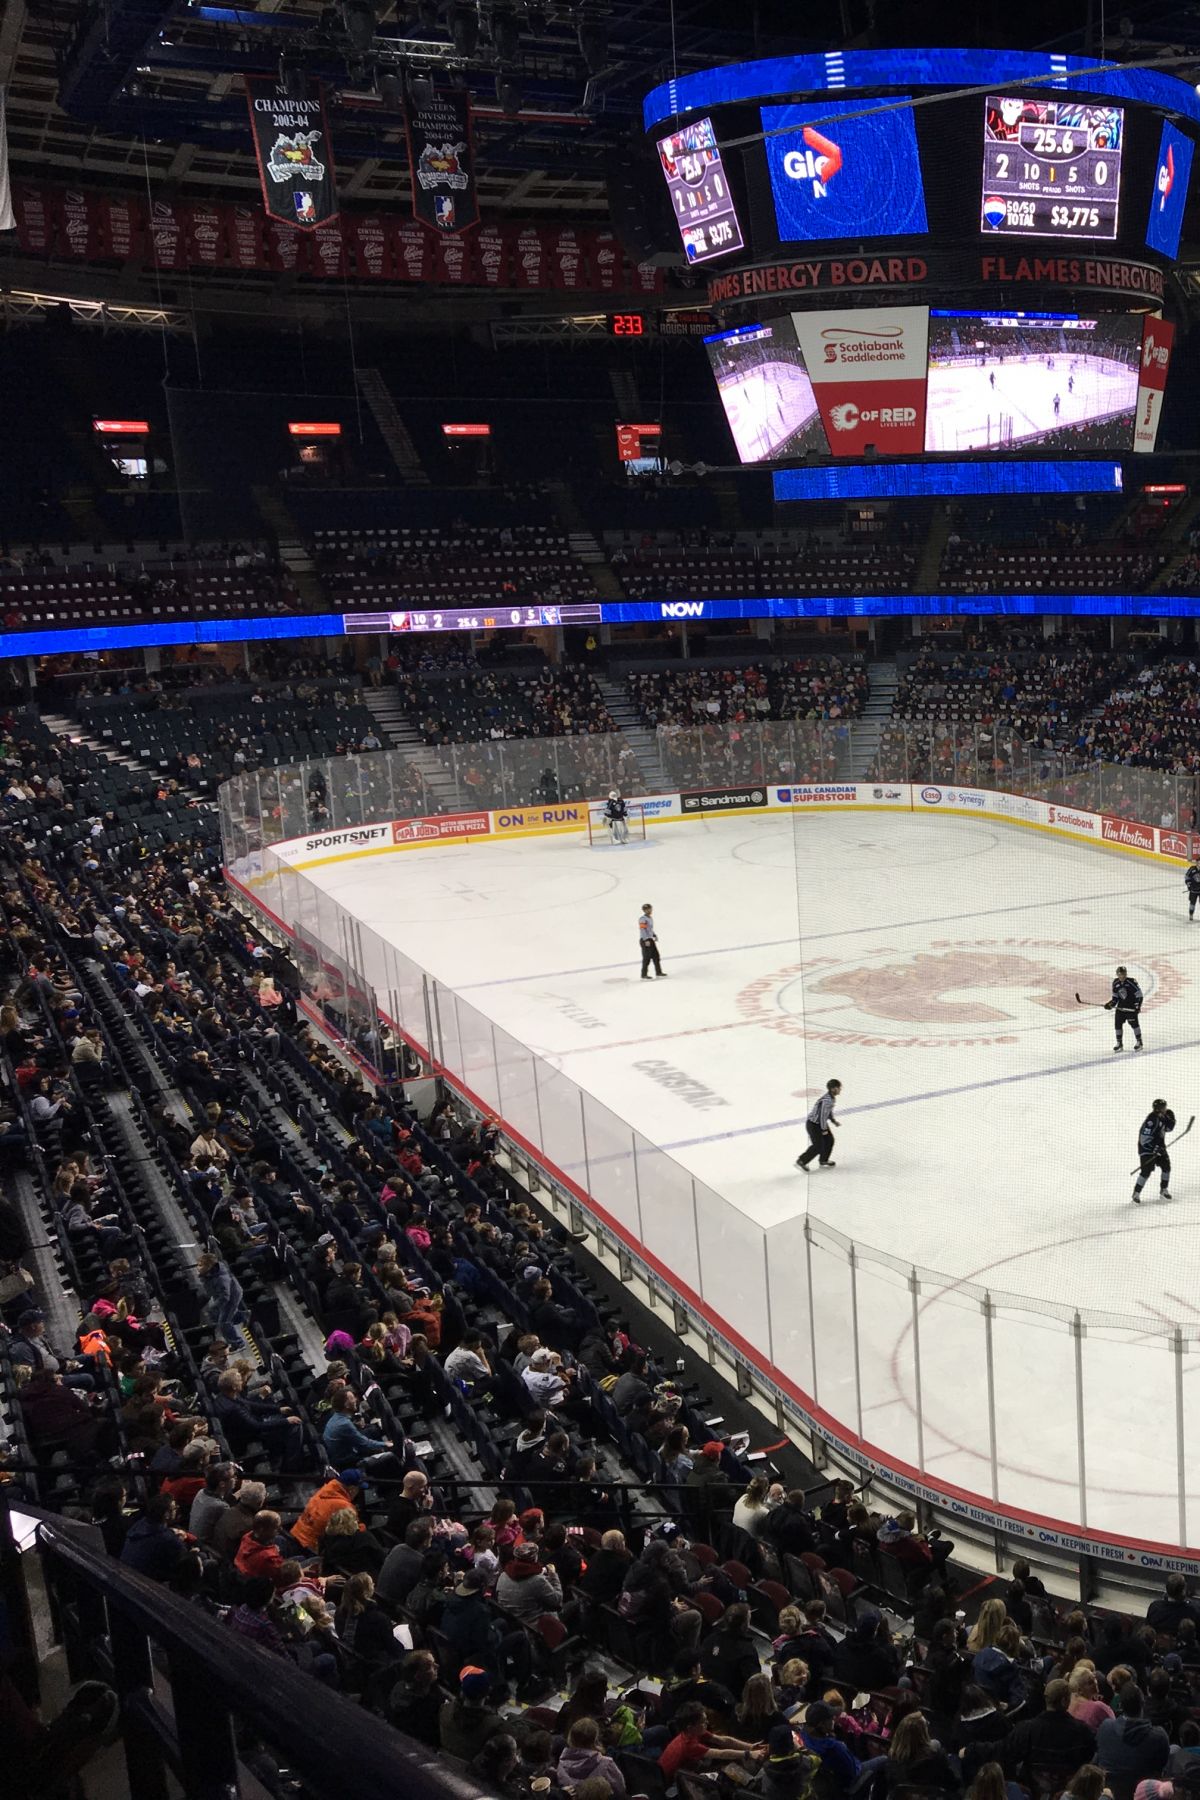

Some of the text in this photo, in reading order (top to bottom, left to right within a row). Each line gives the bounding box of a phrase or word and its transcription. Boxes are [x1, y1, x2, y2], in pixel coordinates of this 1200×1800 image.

[255, 99, 321, 113] CHAMPIONS
[273, 114, 309, 127] 2003-04
[412, 121, 464, 132] CHAMPIONS
[1034, 128, 1073, 154] 25.6
[996, 154, 1009, 178] 2
[1024, 163, 1040, 180] 10
[1068, 166, 1078, 182] 5
[1095, 161, 1108, 185] 0
[1019, 182, 1040, 191] SHOTS
[1065, 185, 1085, 193] SHOTS
[675, 190, 685, 212] 2
[1007, 201, 1099, 228] 50/50 $3,775
[1007, 213, 1035, 226] TOTAL
[743, 257, 927, 294] ENERGY BOARD
[981, 257, 1080, 281] FLAMES
[1085, 261, 1149, 289] ENERGY
[613, 315, 643, 335] 2:33
[660, 324, 688, 335] ROUGH
[840, 340, 904, 353] Scotiabank
[841, 352, 906, 363] Saddledome
[861, 409, 879, 421] OF
[880, 408, 917, 422] RED
[661, 602, 704, 617] NOW
[413, 614, 426, 624] 10
[433, 614, 443, 628] 2
[457, 617, 478, 628] 25.6
[511, 610, 520, 624] 0
[528, 609, 535, 619] 5
[793, 786, 856, 795] REAL CANADIAN
[793, 793, 856, 801] SUPERSTORE
[925, 791, 939, 799] Esso
[700, 793, 750, 806] Sandman
[958, 793, 986, 807] Synergy
[499, 808, 578, 827] ON the RUN
[1057, 810, 1094, 830] Scotiabank
[441, 825, 465, 833] BETTER
[1103, 819, 1119, 839] Tim
[1120, 824, 1153, 849] Hortons
[306, 827, 388, 850] SPORTSNET
[880, 1468, 941, 1503] OPA! KEEPING IT FRESH
[952, 1502, 1024, 1535] OPA! KEEPING IT FRESH
[1039, 1531, 1124, 1560] OPA! KEEPING IT FRESH
[1141, 1555, 1163, 1567] OPA!
[1166, 1561, 1199, 1574] KEEPING
